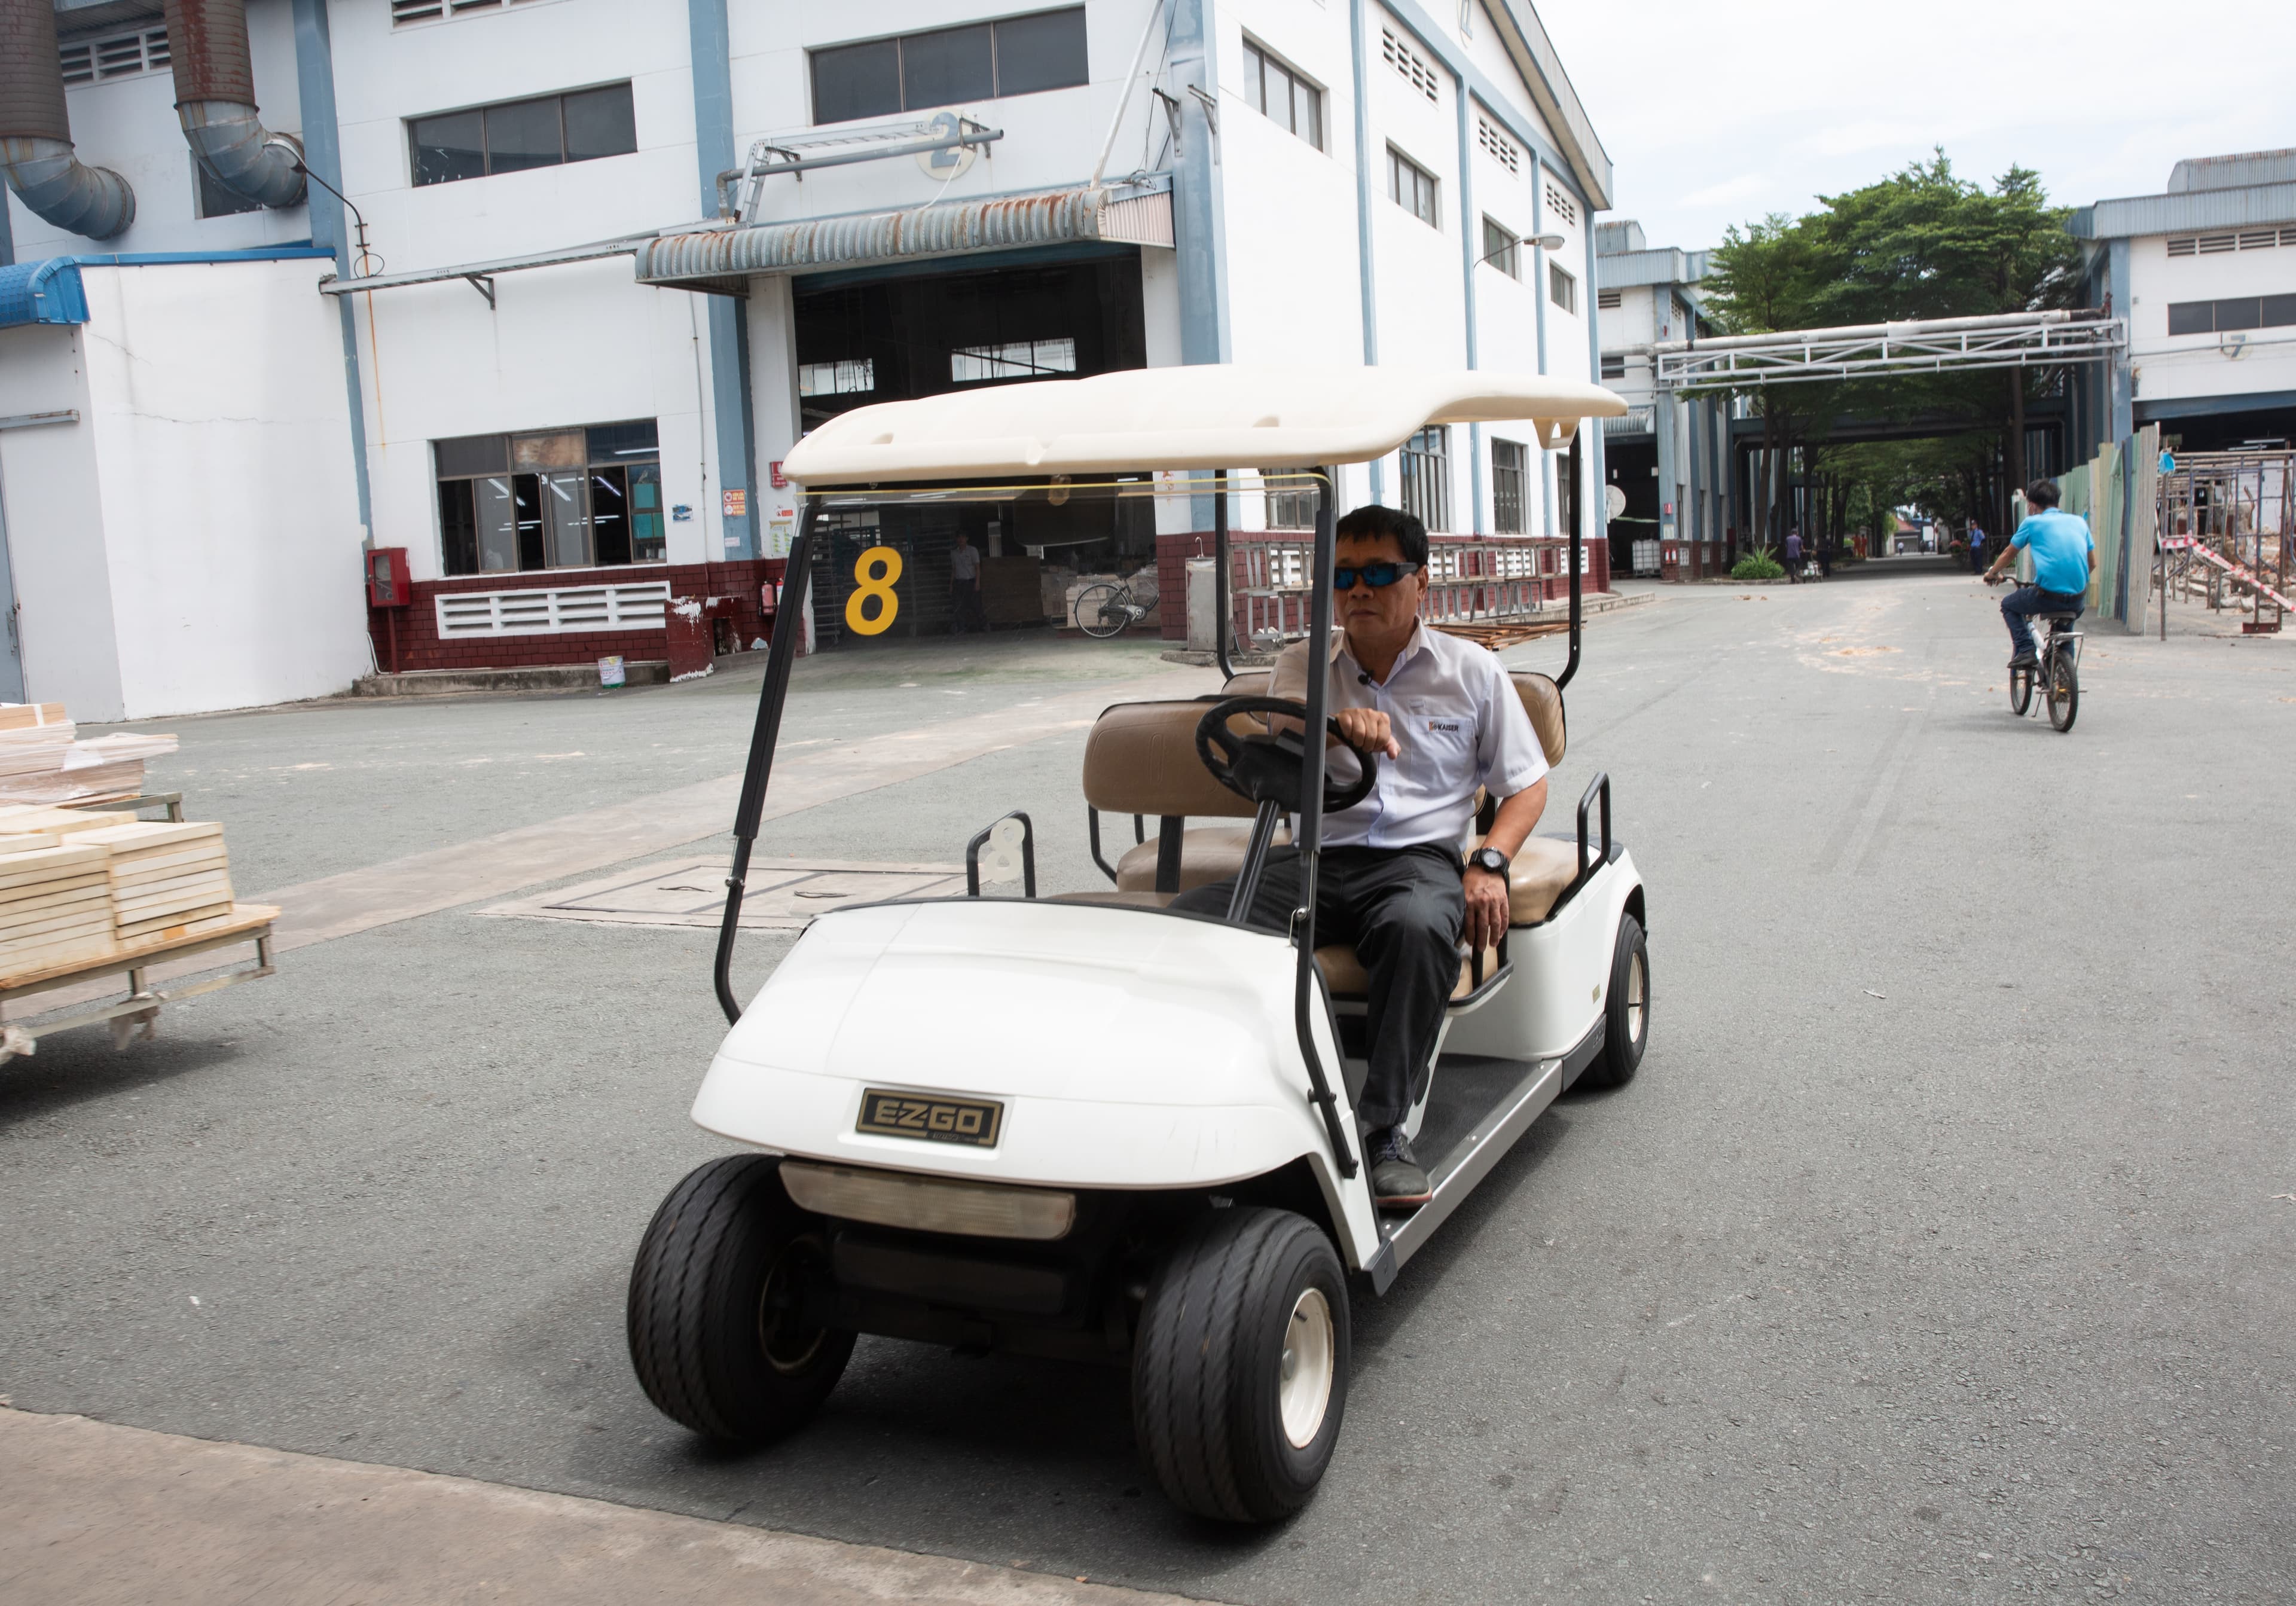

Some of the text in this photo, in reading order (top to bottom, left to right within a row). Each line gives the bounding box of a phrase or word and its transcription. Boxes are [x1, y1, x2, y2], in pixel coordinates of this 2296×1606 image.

[931, 112, 961, 169] 2
[2230, 334, 2246, 358] 7
[845, 546, 903, 636] 8
